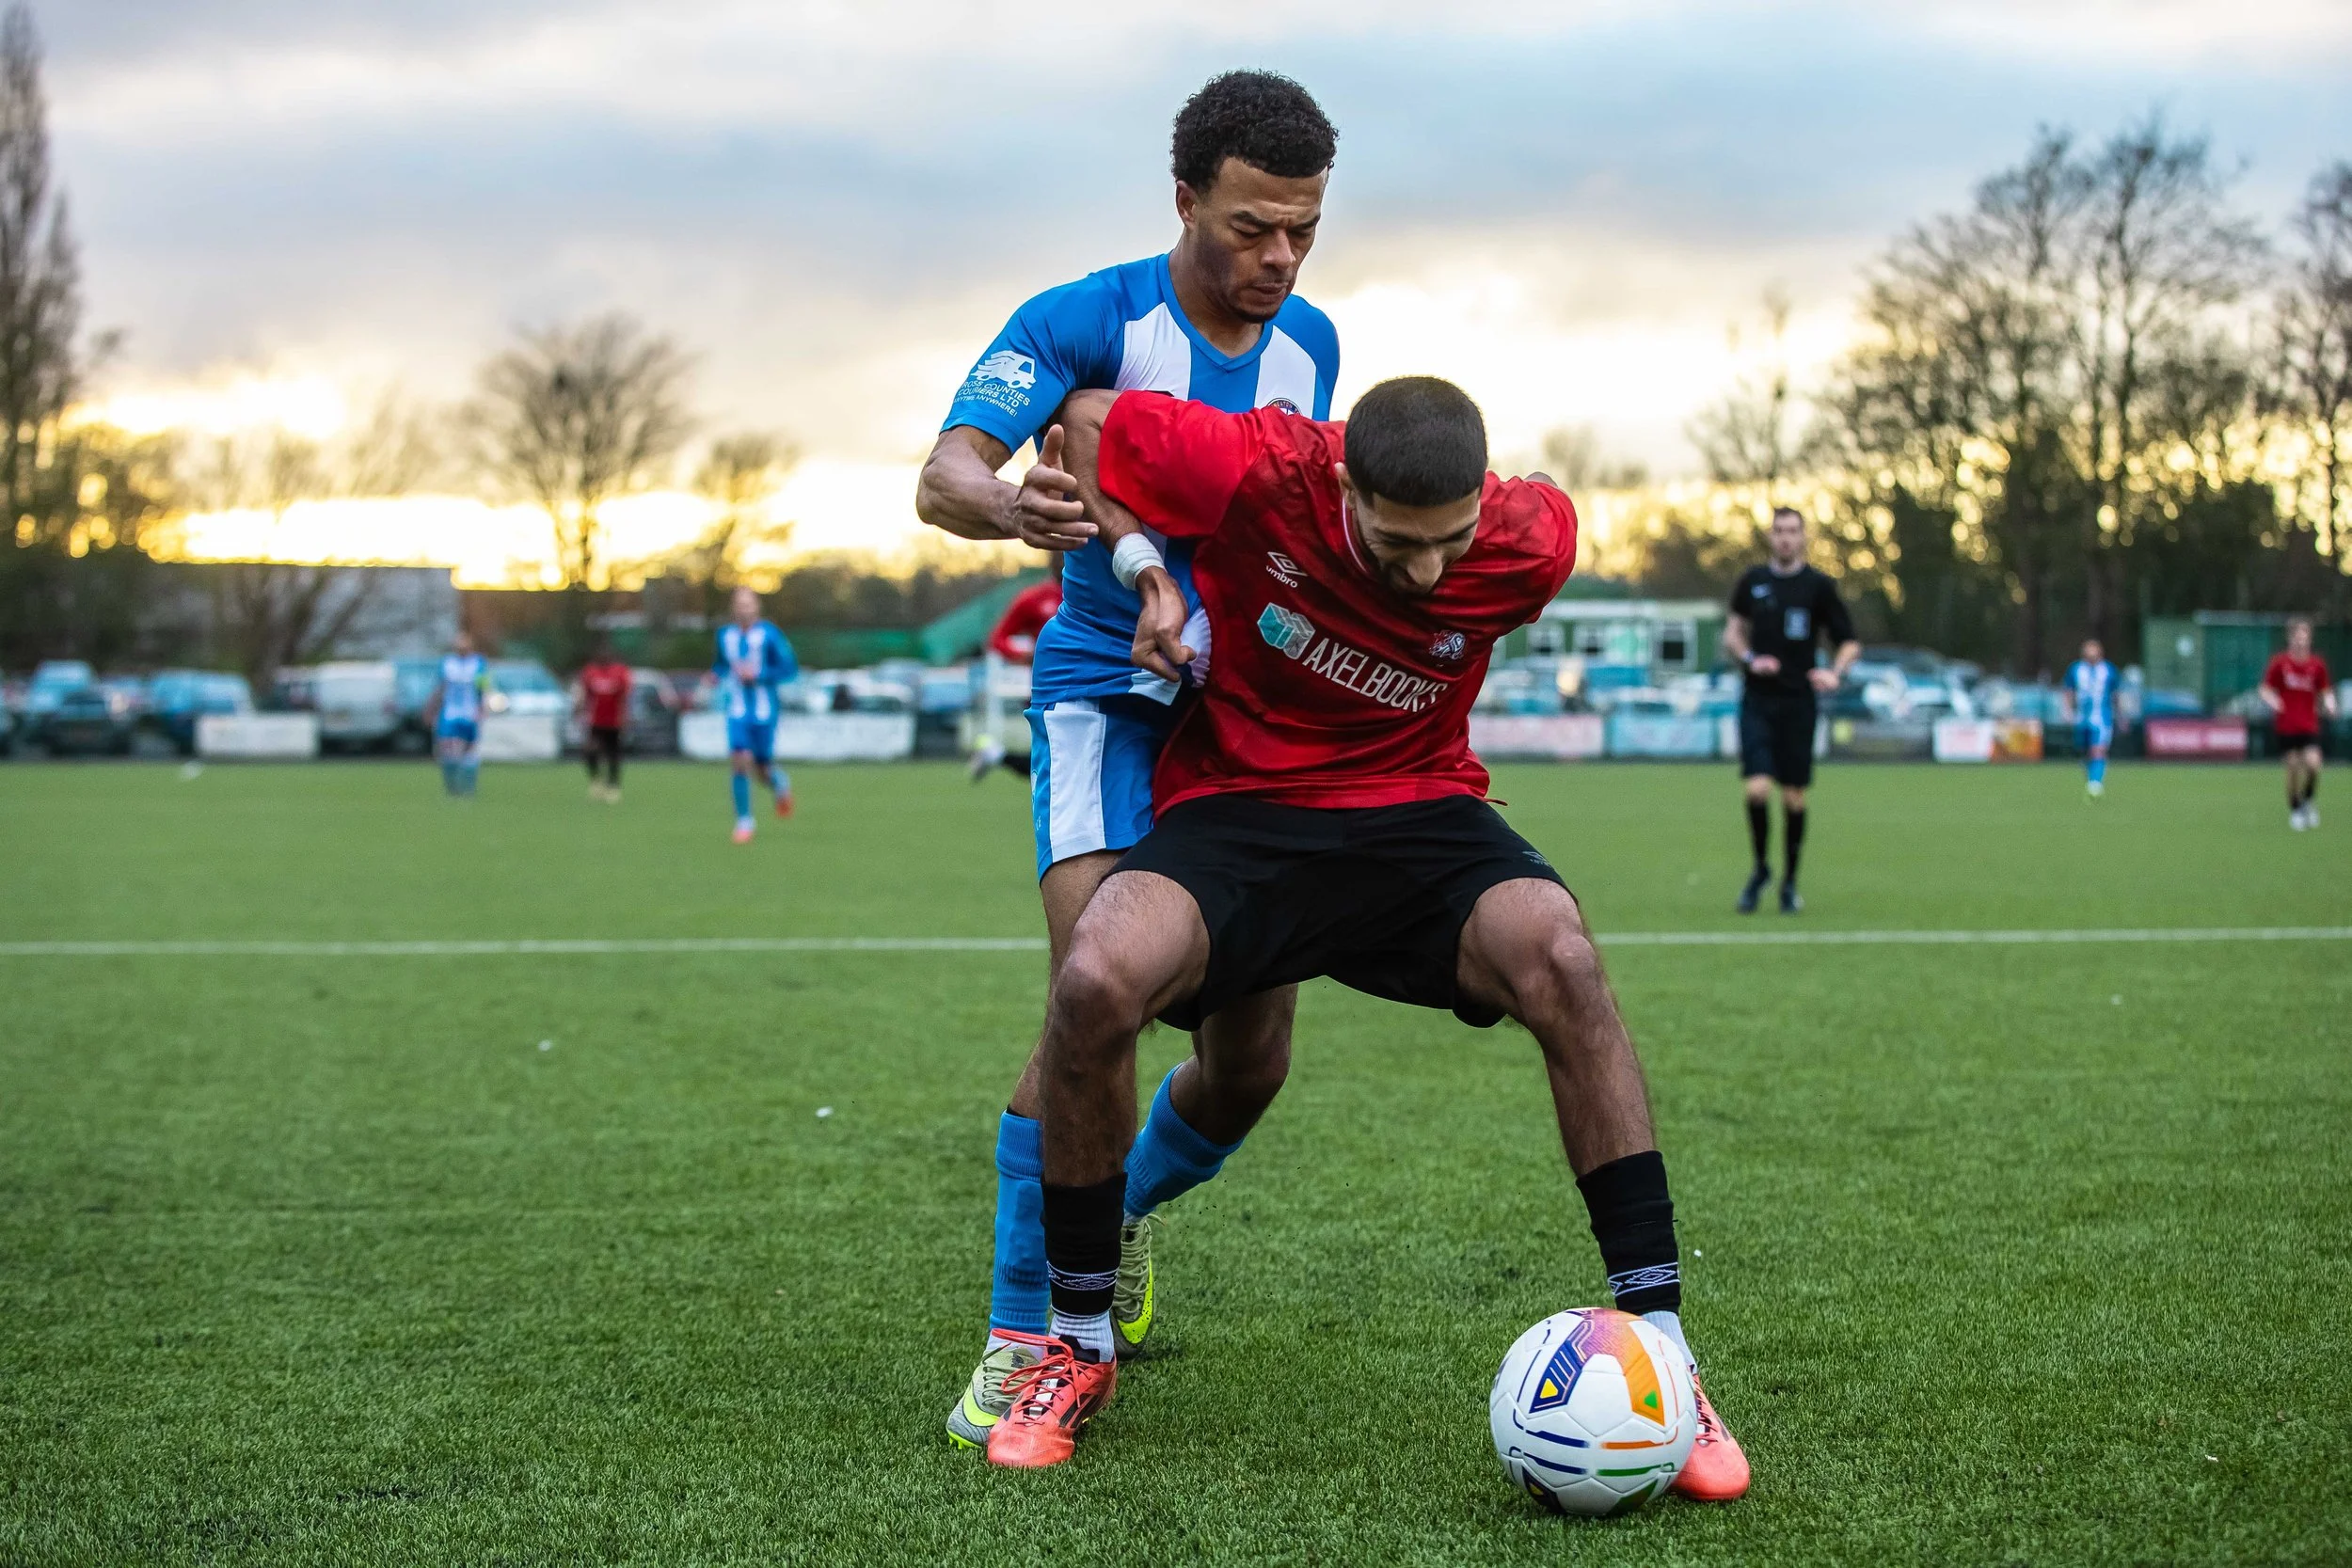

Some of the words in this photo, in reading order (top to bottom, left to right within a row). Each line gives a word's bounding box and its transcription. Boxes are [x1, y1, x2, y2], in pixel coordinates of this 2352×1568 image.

[961, 380, 984, 388] ROSS
[984, 383, 1031, 406] COUNTIES
[1000, 393, 1020, 407] LTD
[1265, 565, 1297, 588] umbro
[1302, 638, 1449, 712] AXELBOOKS
